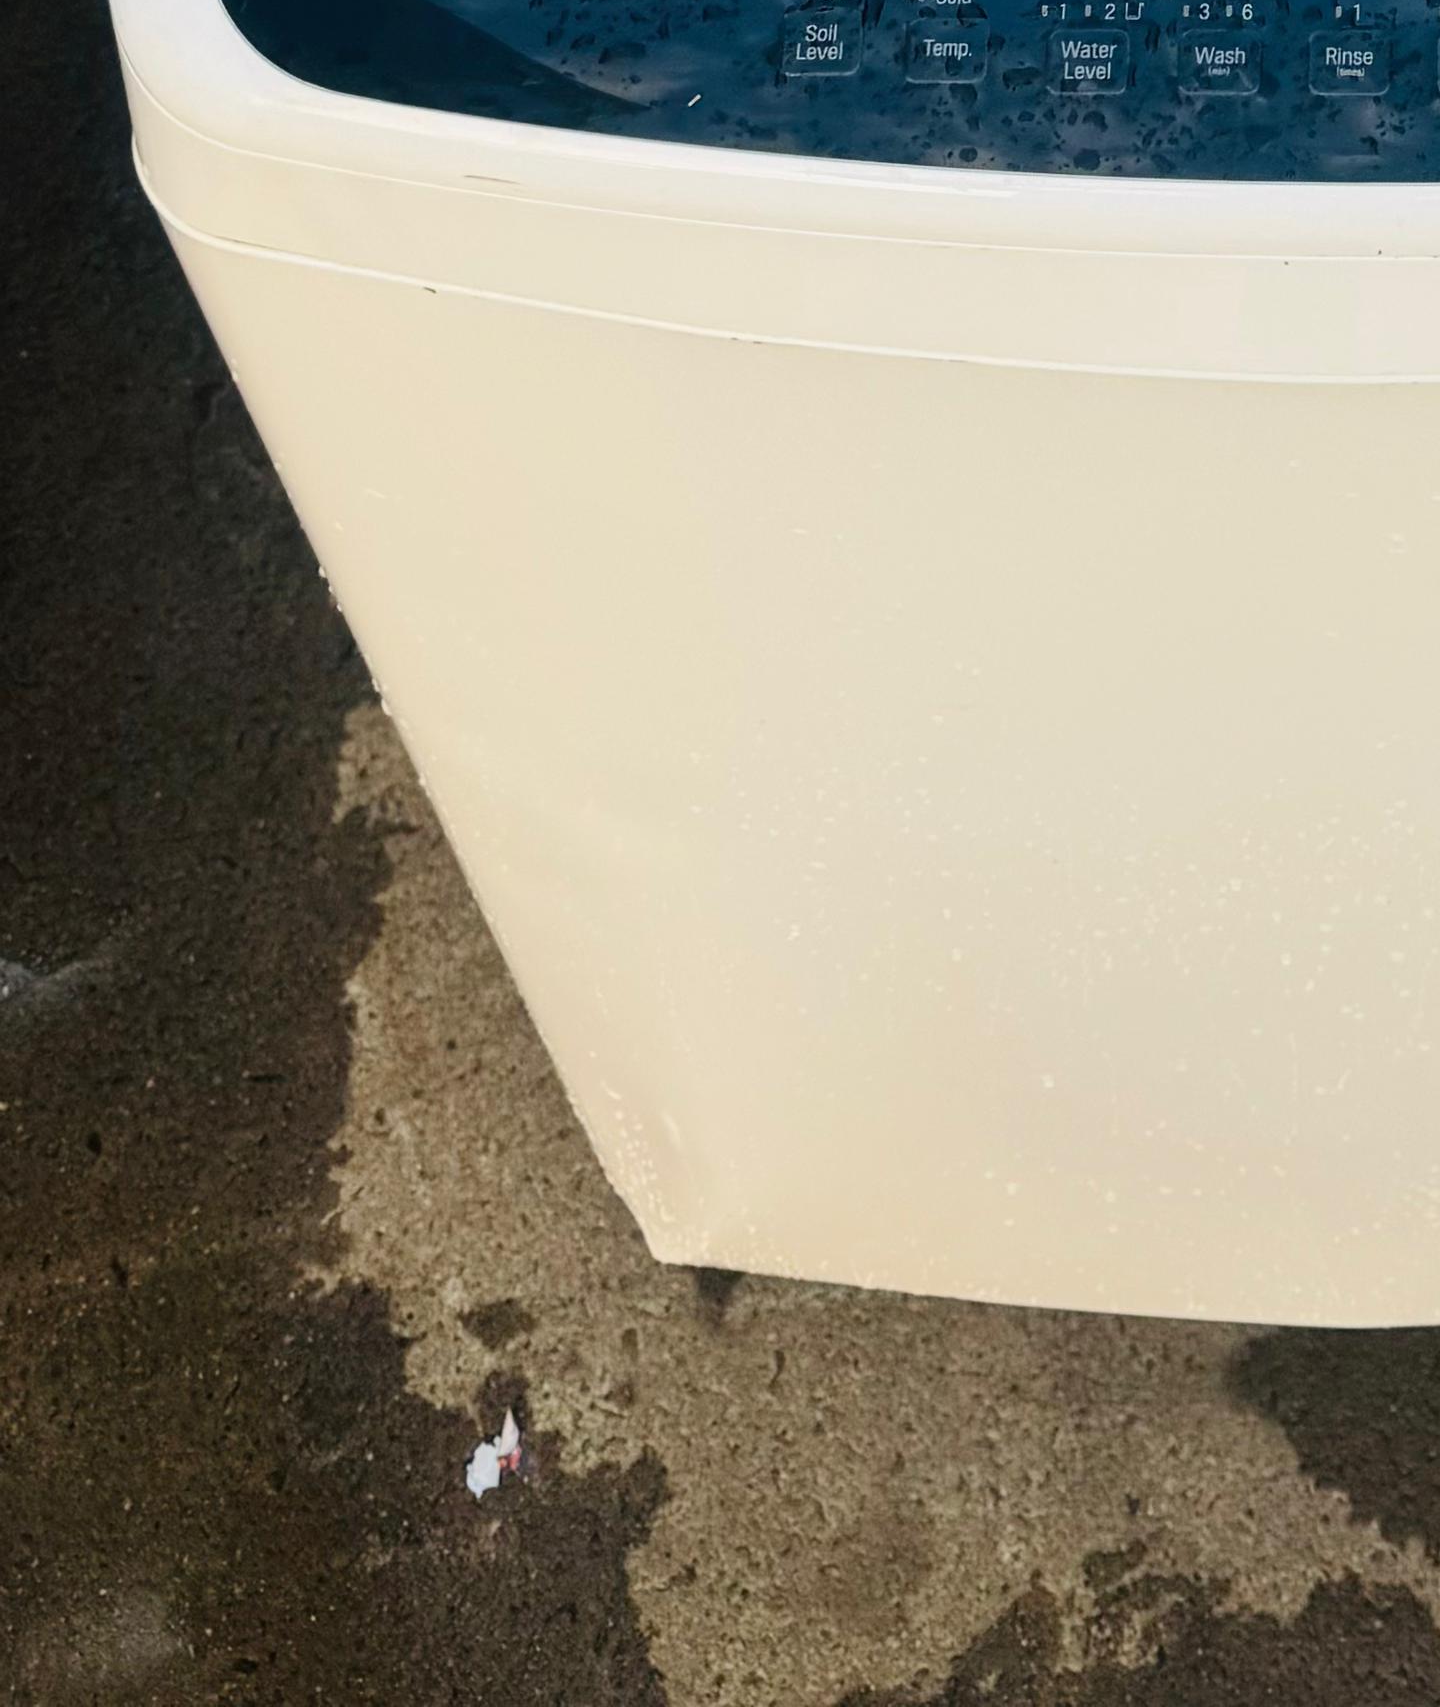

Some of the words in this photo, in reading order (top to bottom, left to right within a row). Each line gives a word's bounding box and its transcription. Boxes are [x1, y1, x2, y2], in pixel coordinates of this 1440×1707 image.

[1059, 4, 1067, 20] 1
[1104, 4, 1116, 21] 2
[1199, 4, 1211, 21] 3
[1242, 4, 1253, 21] 6
[1353, 5, 1361, 21] 1
[804, 23, 838, 43] Soil
[796, 42, 844, 62] Level
[923, 39, 973, 59] Temp.
[1061, 41, 1118, 60] Water
[1194, 46, 1246, 66] Wash
[1325, 47, 1374, 66] Rinse
[1064, 61, 1112, 81] Level
